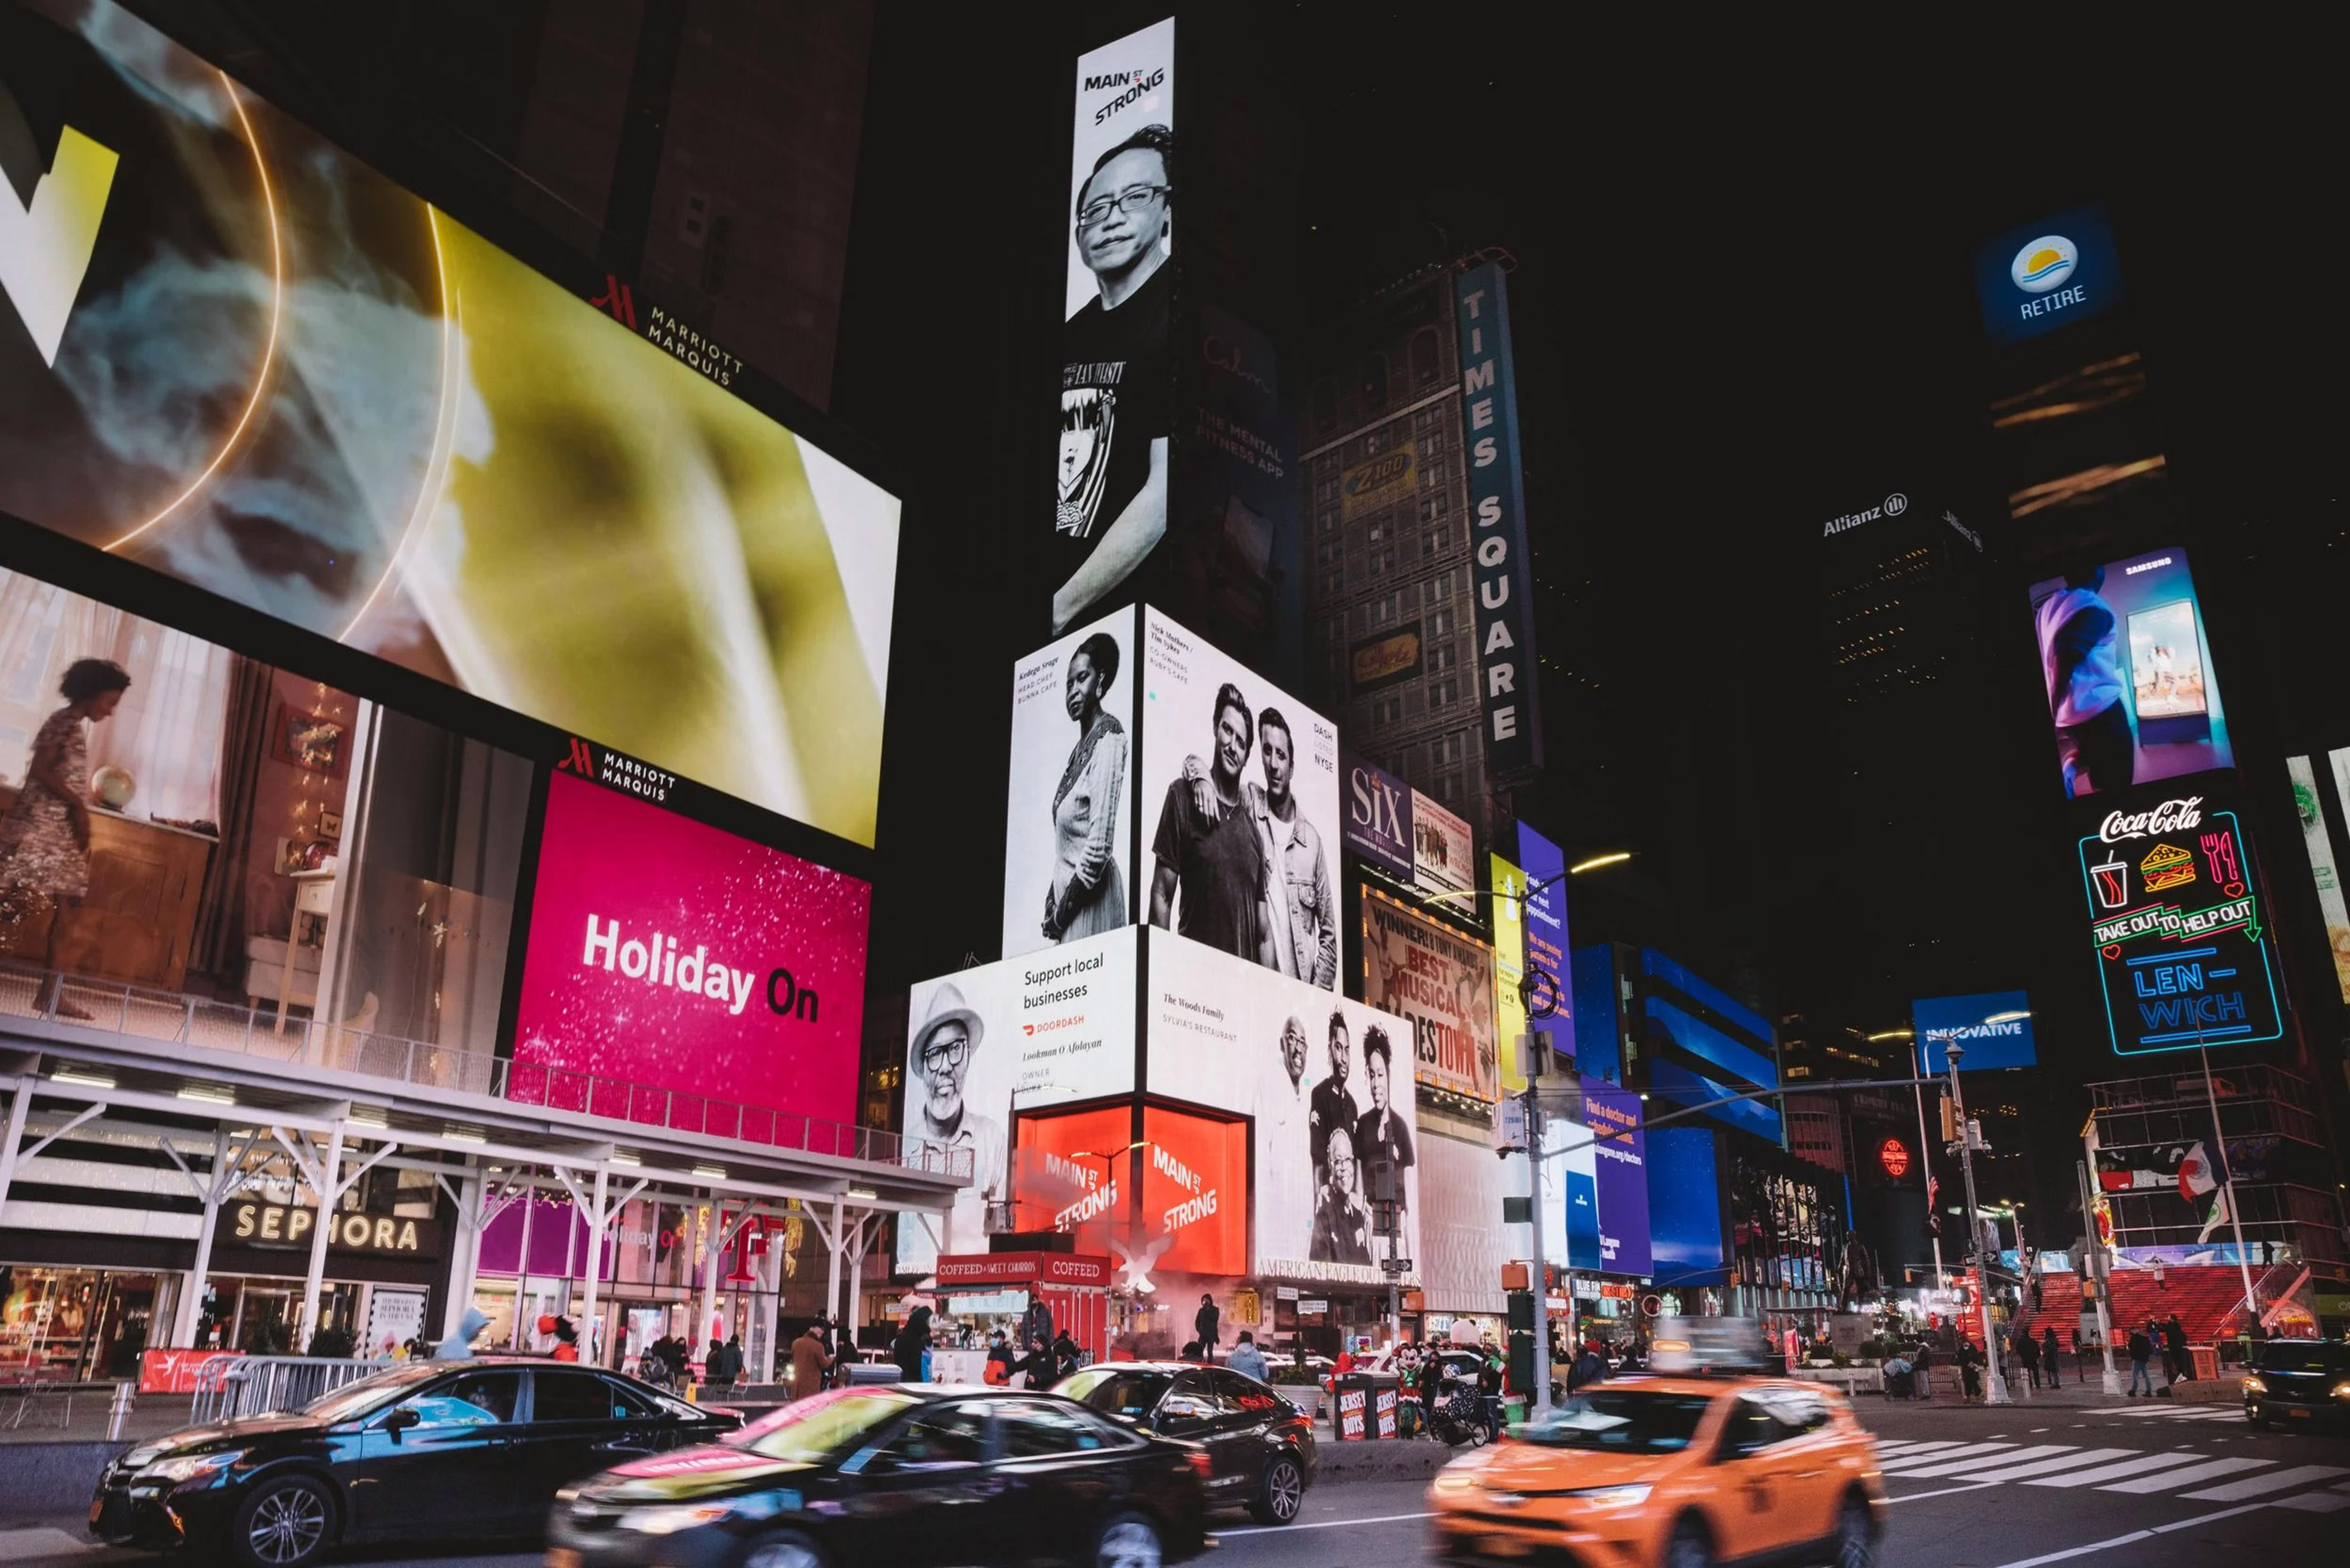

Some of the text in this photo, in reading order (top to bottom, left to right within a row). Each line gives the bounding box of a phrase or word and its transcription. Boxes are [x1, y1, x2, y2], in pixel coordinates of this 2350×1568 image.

[1084, 72, 1130, 91] MAIN
[1095, 68, 1163, 126] STRONG
[2020, 285, 2086, 320] RETIRE
[649, 325, 730, 385] MARQUIS
[651, 306, 742, 373] MARRIOTT
[1196, 406, 1283, 463] THE MENTAL
[1196, 424, 1285, 481] FITNESS APP
[1463, 289, 1517, 742] TIMES SQUARE
[1824, 506, 1881, 537] Allianz
[2126, 557, 2172, 575] SAMSUNG
[1314, 723, 1332, 742] DASH
[605, 753, 675, 788] MARRIOTT
[1315, 753, 1333, 772] NYSE
[602, 767, 665, 801] MARQUIS
[1352, 767, 1406, 847] SIX
[2100, 796, 2203, 843] Coca-Cola
[1372, 905, 1429, 948] WINNER!
[2094, 901, 2250, 942] TAKE OUT TO HELP OUT
[583, 913, 818, 1023] Holiday On
[1025, 952, 1103, 986] Support local
[1407, 945, 1449, 986] BEST
[1024, 985, 1087, 1009] businesses
[1163, 994, 1225, 1022] The Woods Family
[1395, 972, 1465, 1020] MUSICAL
[2138, 992, 2246, 1029] WICH
[1037, 1015, 1084, 1033] DOORDASH
[1376, 1001, 1475, 1076] DESTOWN
[1926, 1023, 2021, 1041] INNOVATIVE
[1022, 1048, 1057, 1062] Lookman
[1022, 1068, 1050, 1081] OWNER
[1046, 1153, 1098, 1188] MAIN ST
[1154, 1144, 1201, 1190] MAIN ST
[1054, 1179, 1117, 1233] STRONG
[1163, 1189, 1217, 1233] STRONG
[940, 1264, 983, 1276] COFFEED
[987, 1262, 1006, 1274] SWEET
[1008, 1261, 1036, 1274] CHURROS
[1053, 1261, 1100, 1277] COFFEED
[1260, 1259, 1322, 1280] AMERICAN
[1326, 1262, 1361, 1281] EAGLE
[1340, 1390, 1366, 1413] JERSEY
[1377, 1390, 1396, 1413] JERSEY
[1343, 1414, 1364, 1435] BOYS
[1378, 1414, 1396, 1436] BOYS
